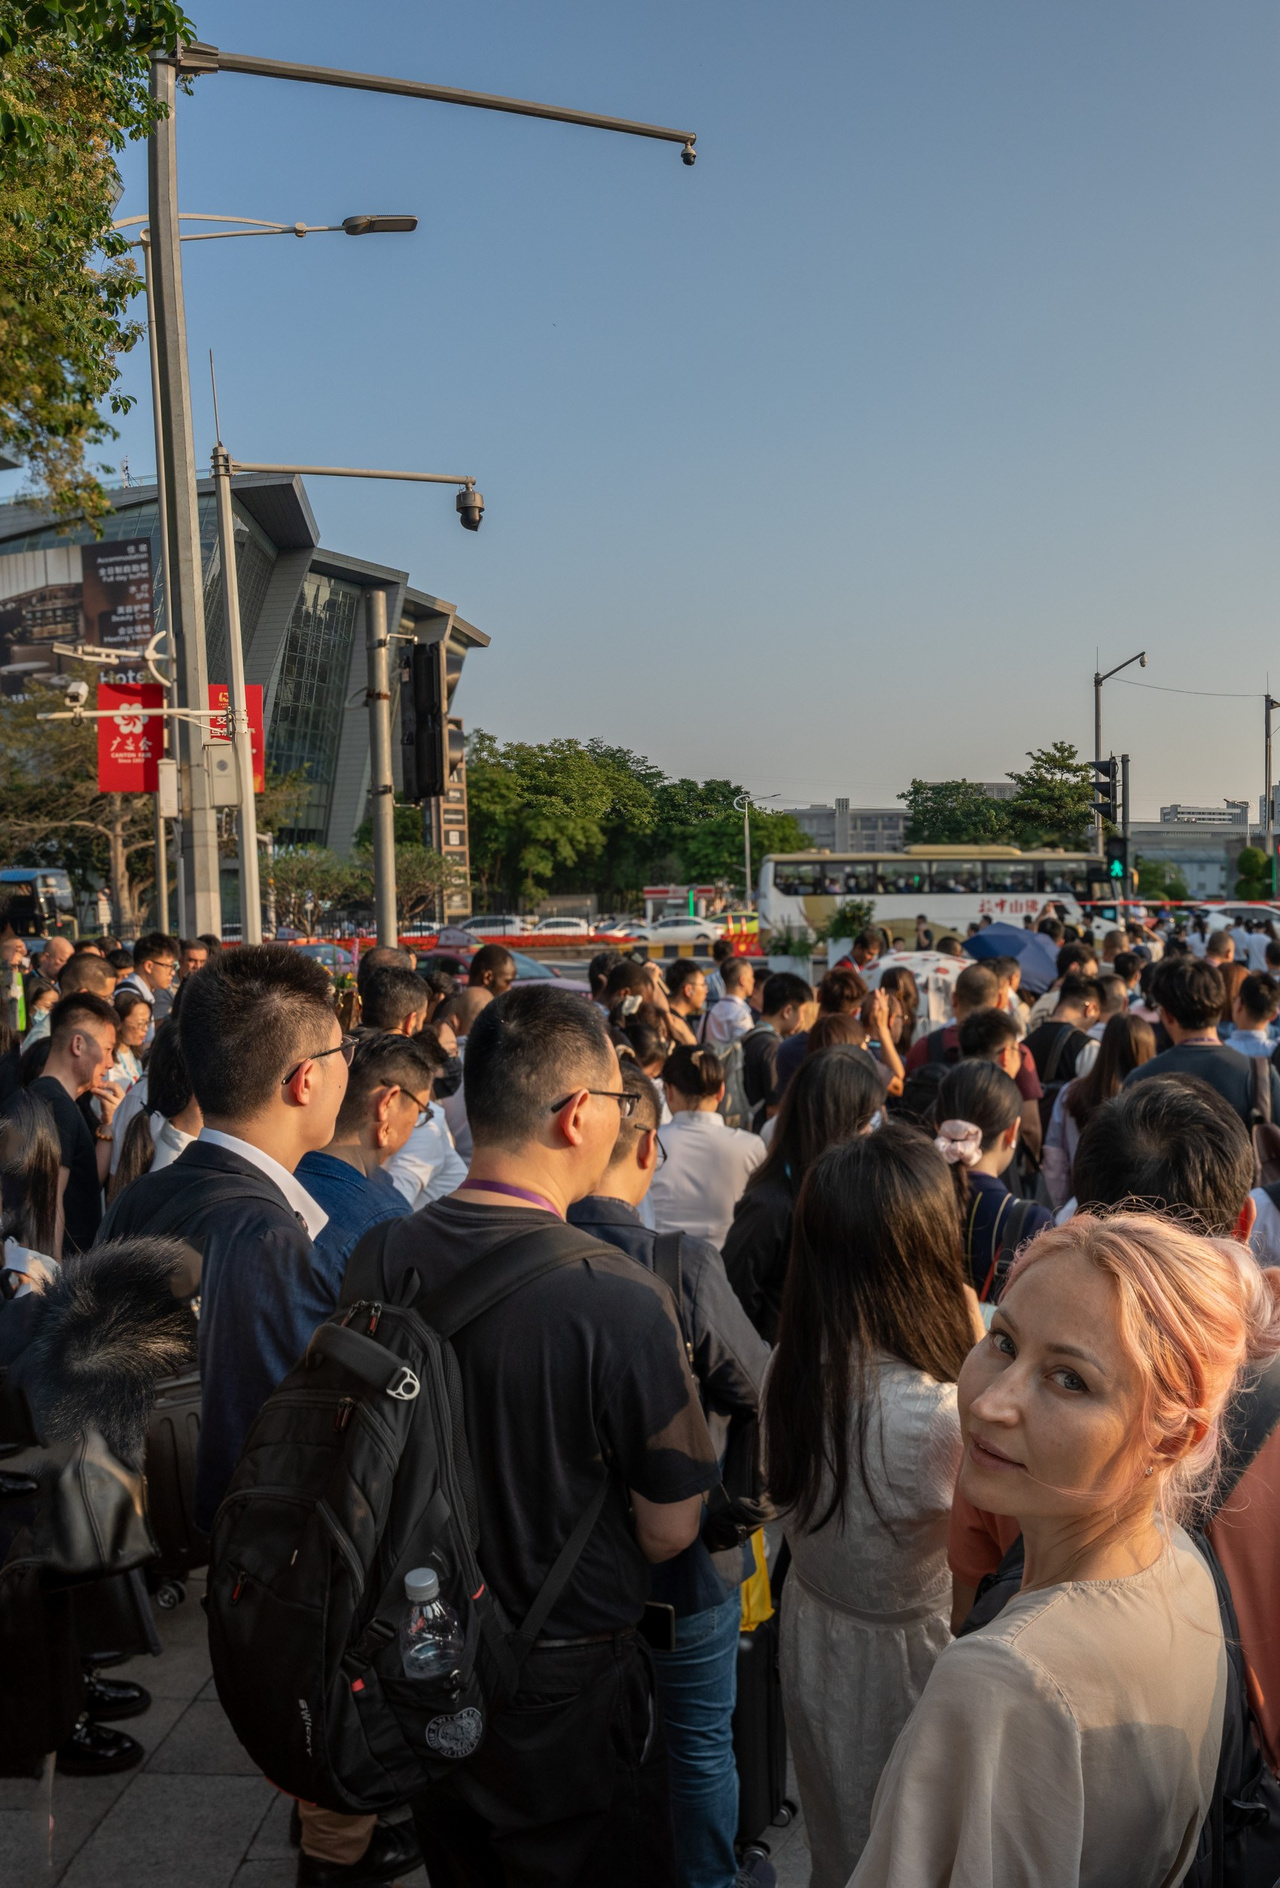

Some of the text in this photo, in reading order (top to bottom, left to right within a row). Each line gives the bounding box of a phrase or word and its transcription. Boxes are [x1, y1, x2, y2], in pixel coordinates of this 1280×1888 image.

[97, 553, 148, 564] Accommodation
[115, 574, 128, 582] day
[128, 572, 149, 580] buffet
[135, 592, 150, 600] SPA
[111, 612, 150, 623] Beauty Care
[103, 632, 151, 643] Meeting Venue
[99, 669, 153, 684] Hote
[298, 1698, 313, 1758] SWICKY
